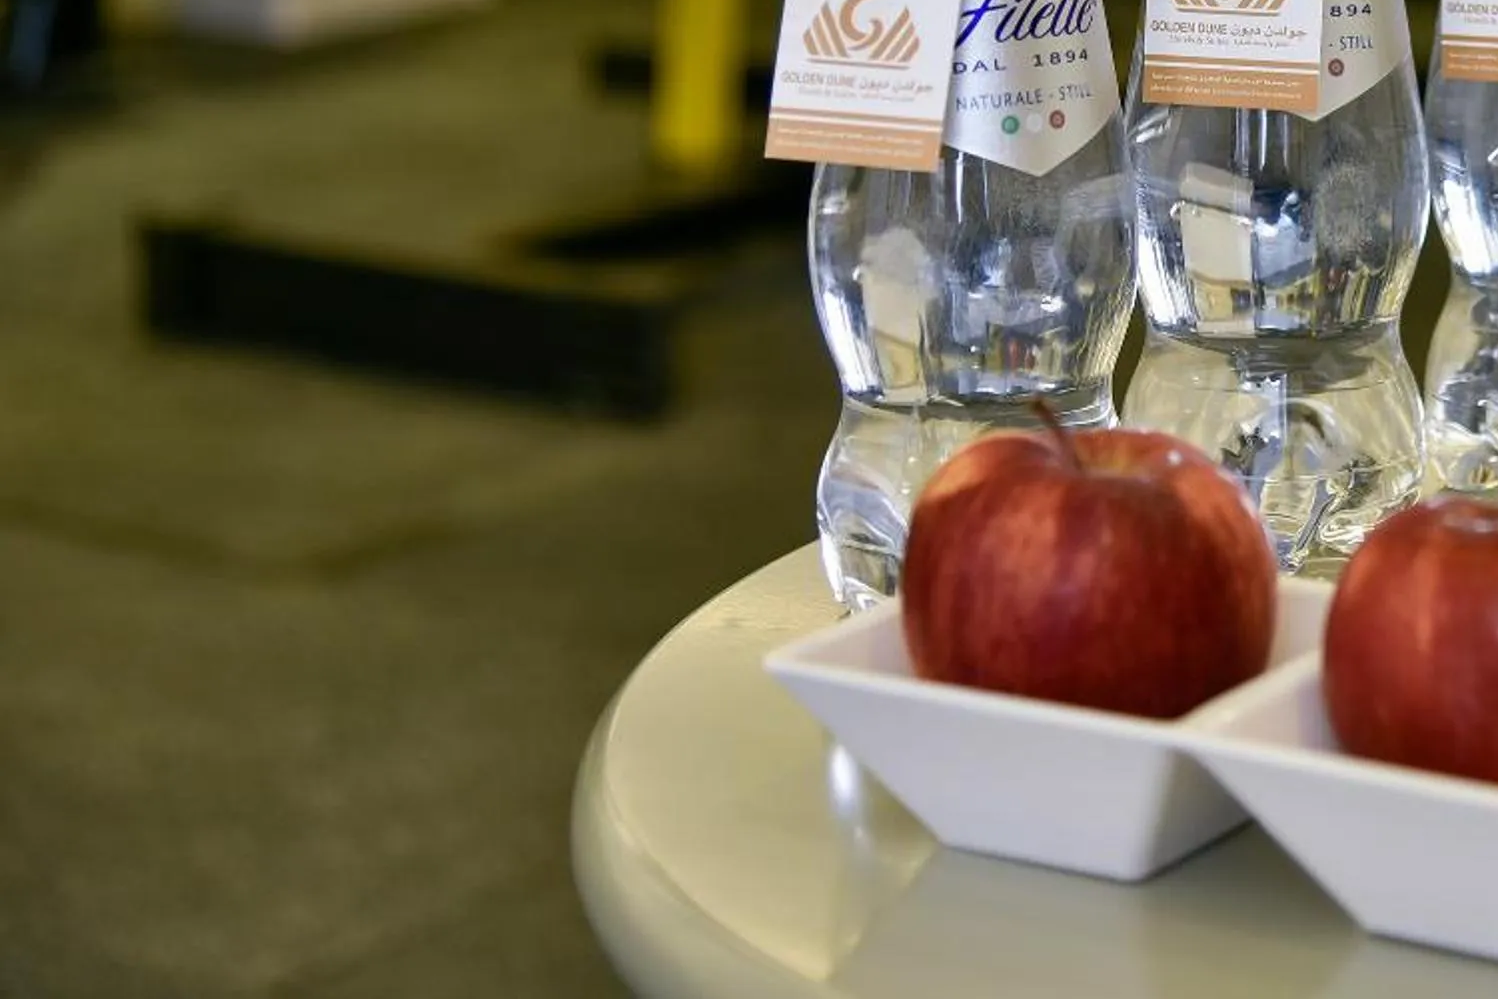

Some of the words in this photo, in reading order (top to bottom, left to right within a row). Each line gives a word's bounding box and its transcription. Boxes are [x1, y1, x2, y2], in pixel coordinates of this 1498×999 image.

[1329, 3, 1372, 17] 894
[1446, 1, 1489, 15] GOLDEN
[1150, 20, 1195, 34] GOLDEN
[953, 58, 1007, 75] DAL
[1033, 49, 1089, 67] 1894
[781, 70, 824, 86] GOLDEN
[955, 88, 1043, 112] NATURALE
